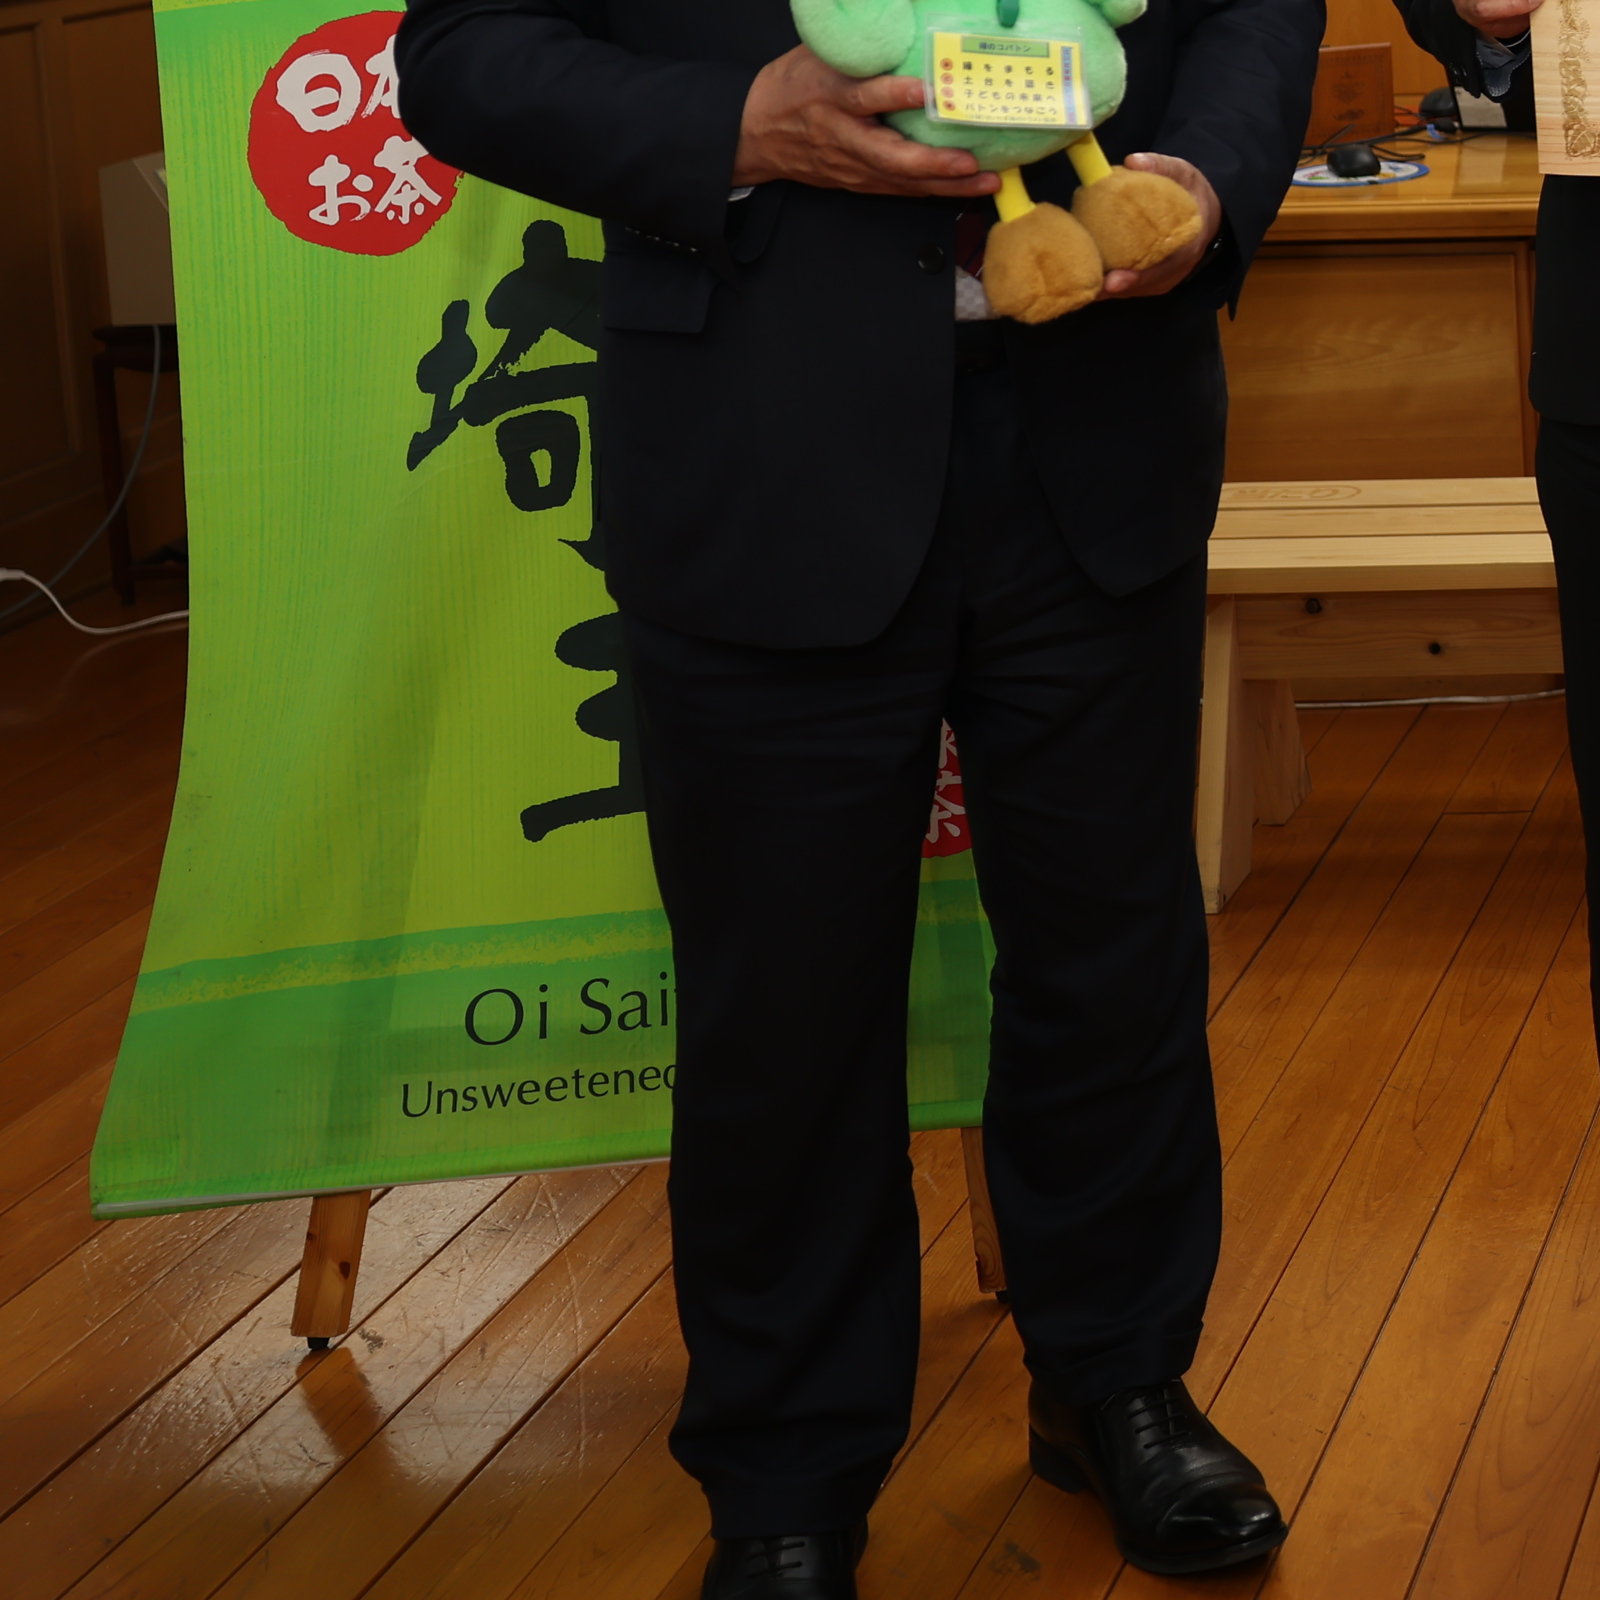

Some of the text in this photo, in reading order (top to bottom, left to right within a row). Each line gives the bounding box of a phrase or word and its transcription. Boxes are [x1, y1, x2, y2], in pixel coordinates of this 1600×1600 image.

[308, 135, 443, 226] お茶
[463, 969, 677, 1046] Oi Sai
